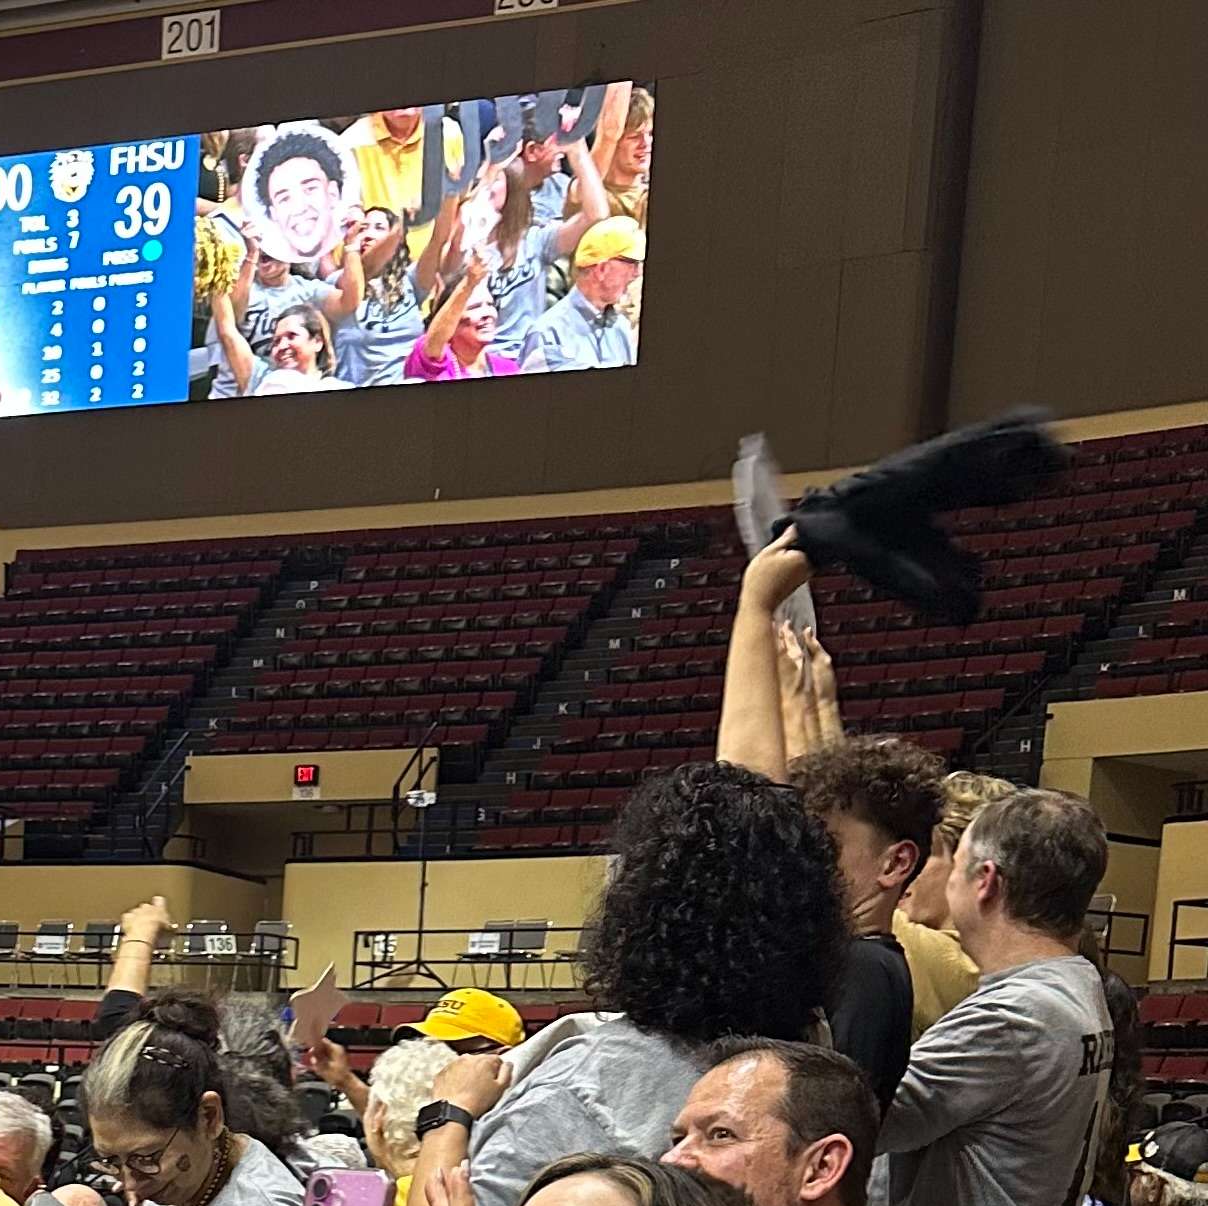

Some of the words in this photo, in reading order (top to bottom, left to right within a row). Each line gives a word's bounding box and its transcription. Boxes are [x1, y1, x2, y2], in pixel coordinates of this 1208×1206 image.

[168, 15, 215, 54] 201
[109, 140, 185, 176] FHSU
[66, 209, 79, 228] 3
[114, 182, 171, 239] 39
[68, 231, 80, 248] 7
[51, 300, 64, 316] 2
[135, 292, 148, 307] 5
[92, 341, 104, 357] 1
[132, 360, 145, 376] 2
[89, 386, 102, 402] 2
[131, 383, 144, 399] 2
